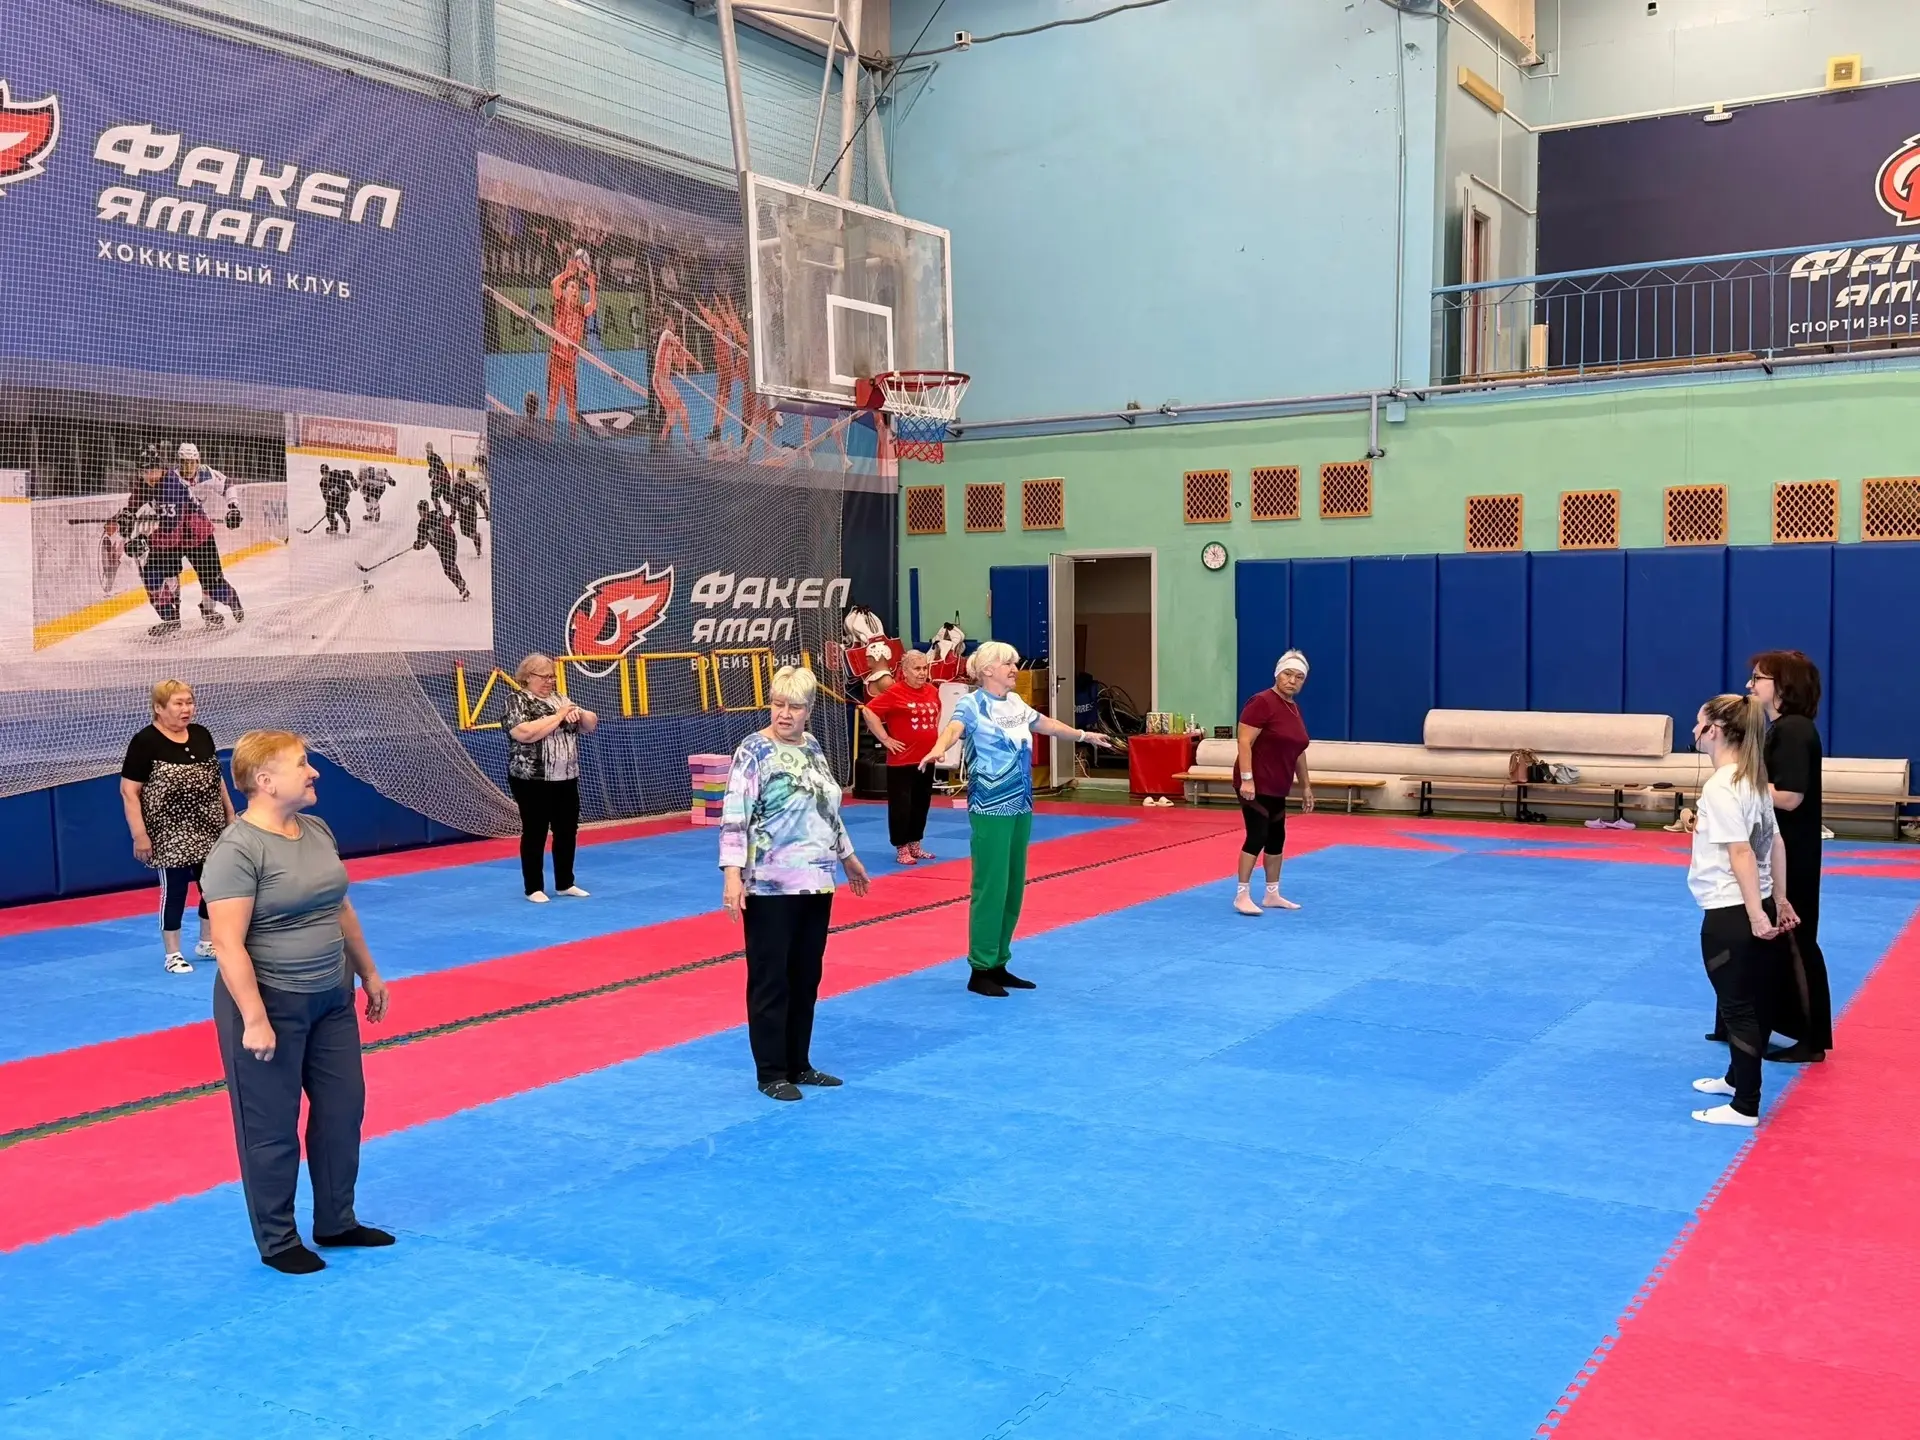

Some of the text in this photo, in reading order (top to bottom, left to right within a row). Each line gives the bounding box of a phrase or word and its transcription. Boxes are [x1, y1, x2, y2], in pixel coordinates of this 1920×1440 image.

[94, 124, 401, 229] ФАКЕЛ
[96, 186, 296, 253] ЯМАЛ
[97, 239, 352, 298] ХОККЕЙНЫЙ КЛУБ
[1835, 279, 1920, 308] ЯМ
[160, 503, 176, 517] 33
[690, 569, 851, 609] ФАКЕЛ
[692, 617, 794, 643] ЯМАЛ
